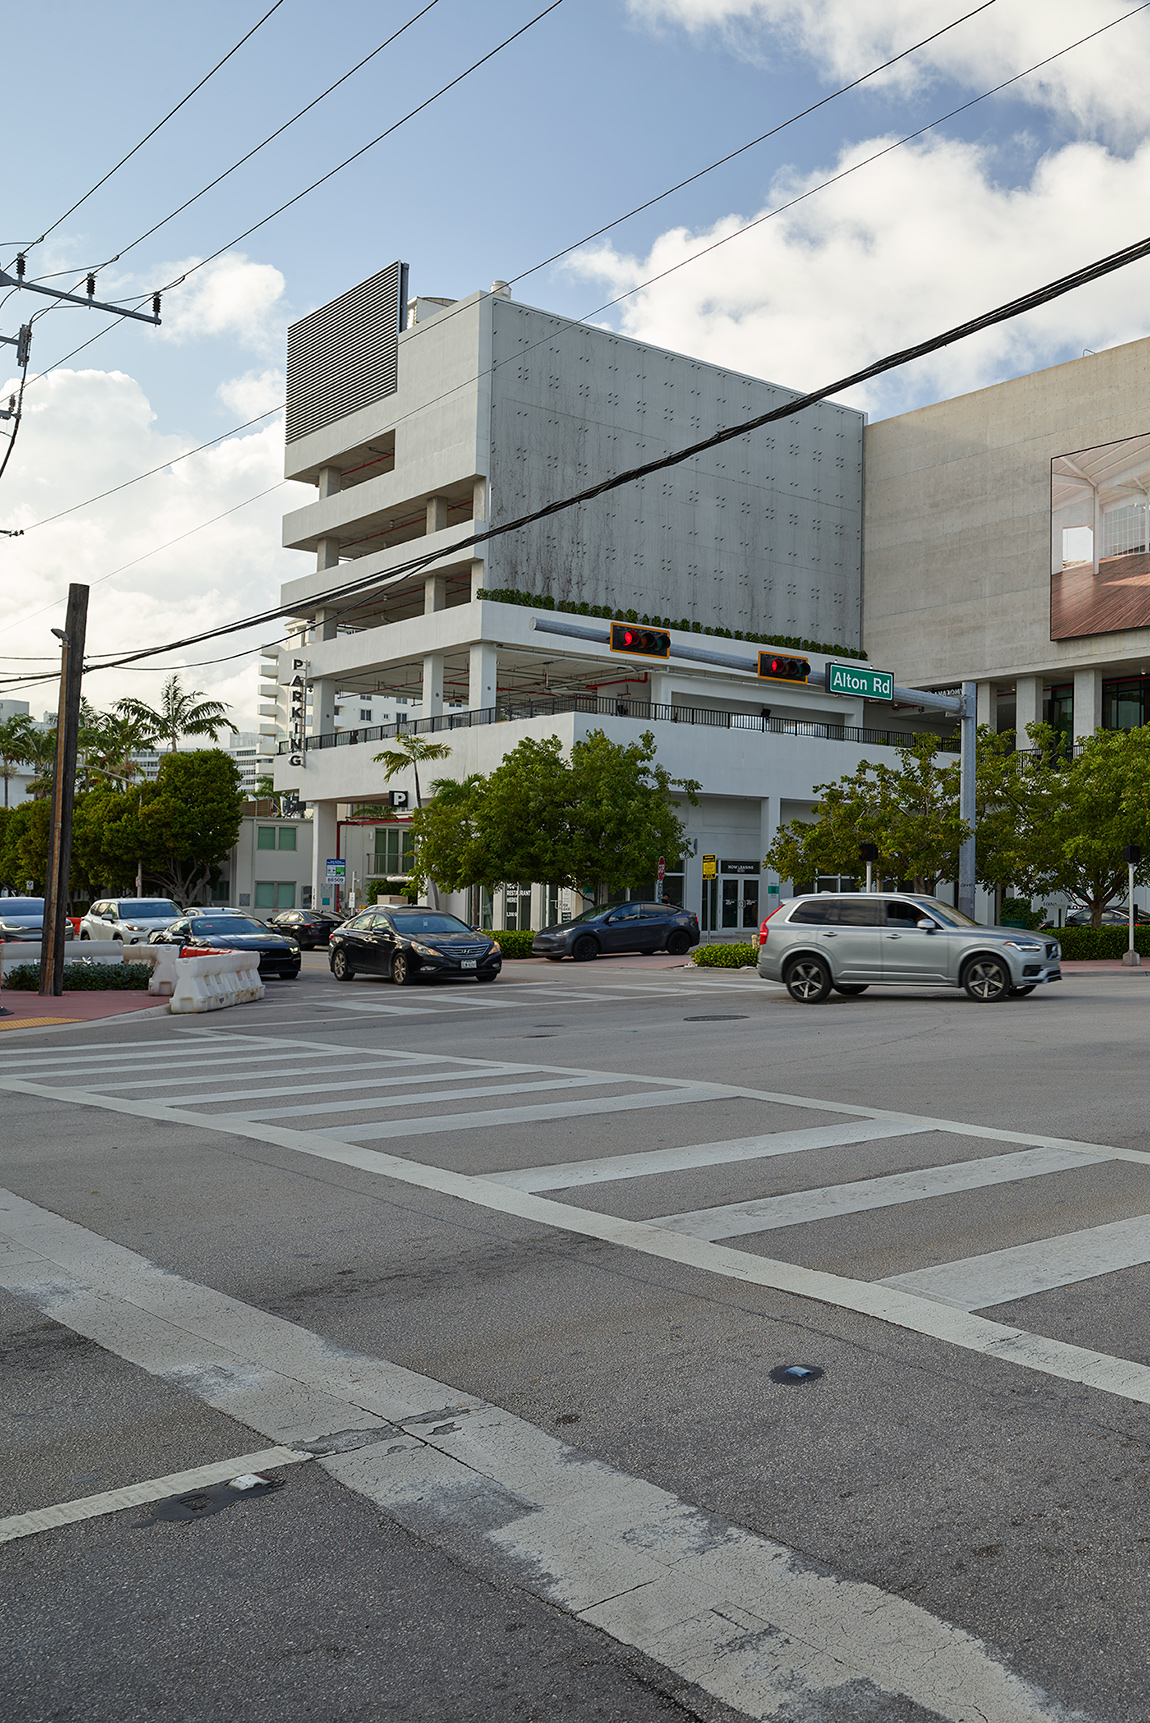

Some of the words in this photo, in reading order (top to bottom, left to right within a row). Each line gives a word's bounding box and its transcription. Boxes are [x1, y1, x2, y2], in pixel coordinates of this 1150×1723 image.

[833, 671, 867, 691] Alton
[873, 677, 890, 694] Rd
[289, 659, 304, 767] PARKING
[393, 791, 406, 806] P
